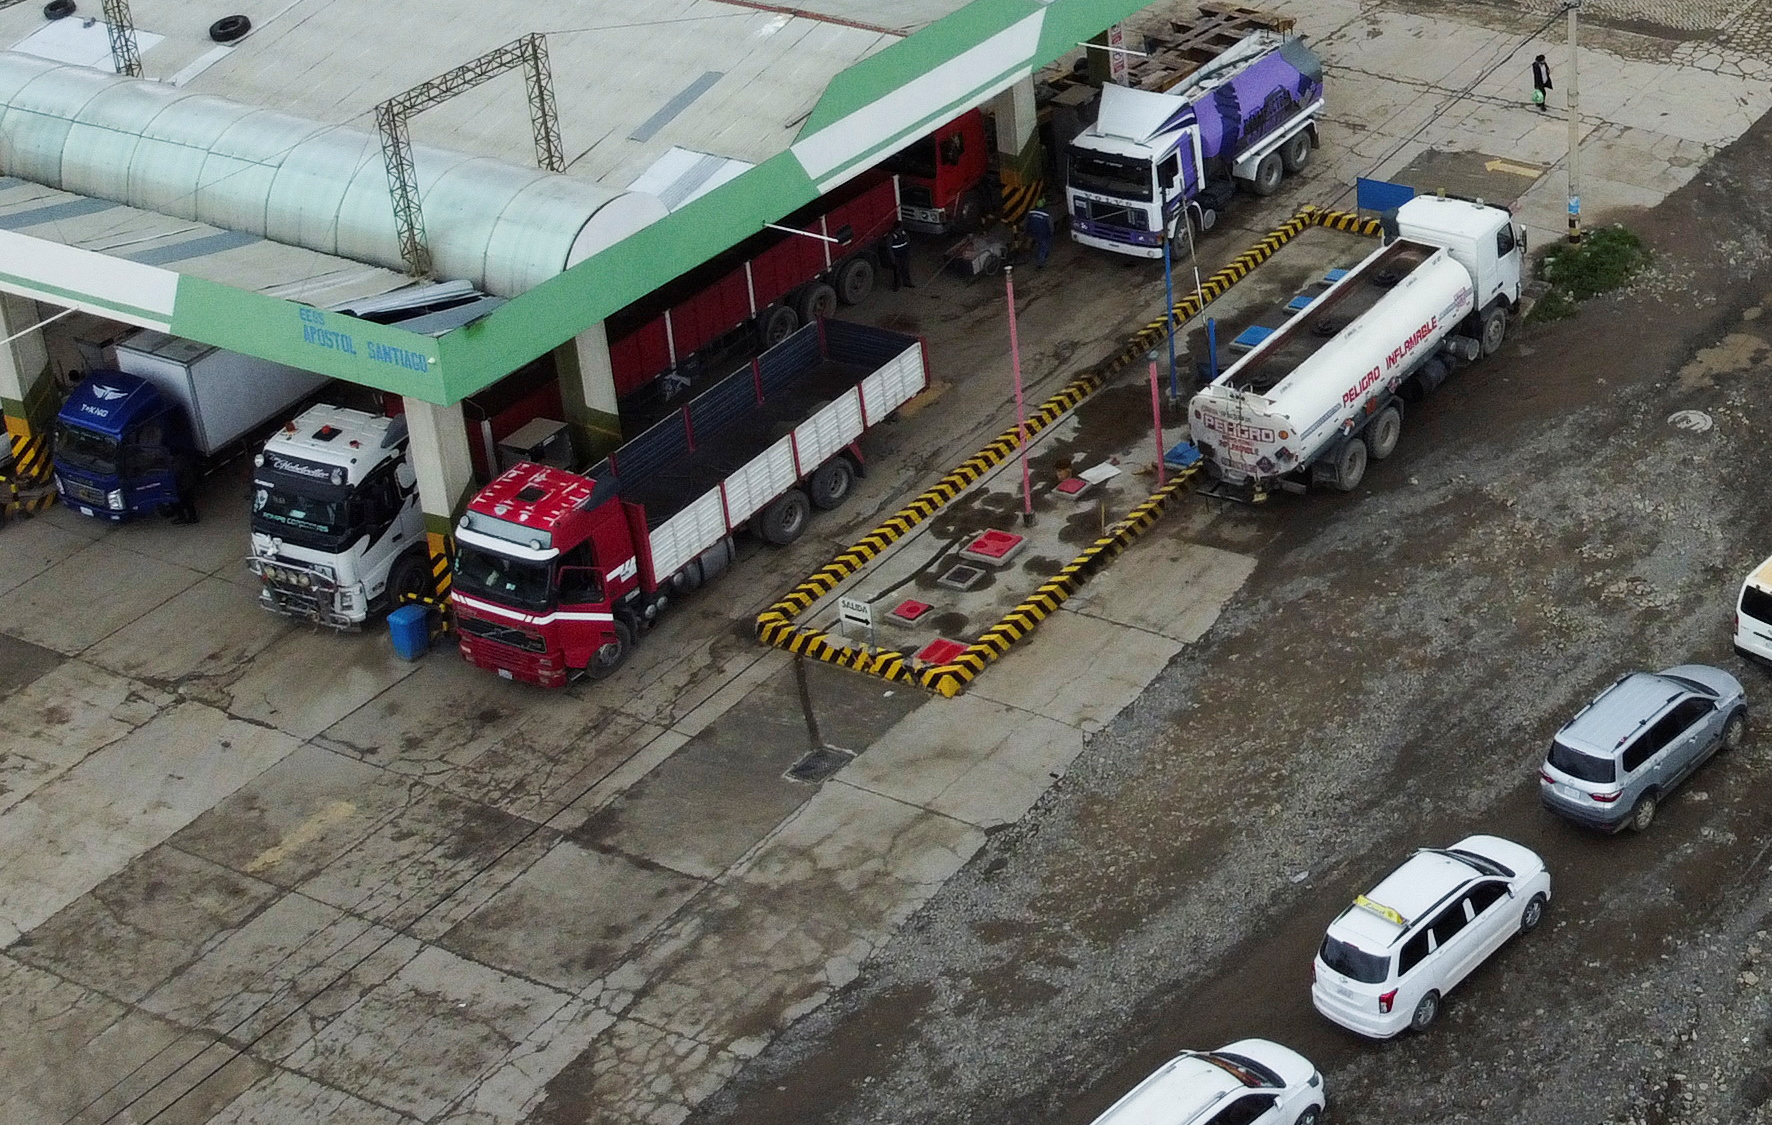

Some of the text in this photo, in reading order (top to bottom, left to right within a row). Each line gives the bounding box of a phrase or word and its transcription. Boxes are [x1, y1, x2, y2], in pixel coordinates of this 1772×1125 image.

[1084, 193, 1133, 207] VOLVO
[303, 324, 429, 373] APOSTOL SANTIAGO
[1342, 315, 1439, 409] PELIGRO INFLAMABLE
[841, 600, 868, 613] SALIDA
